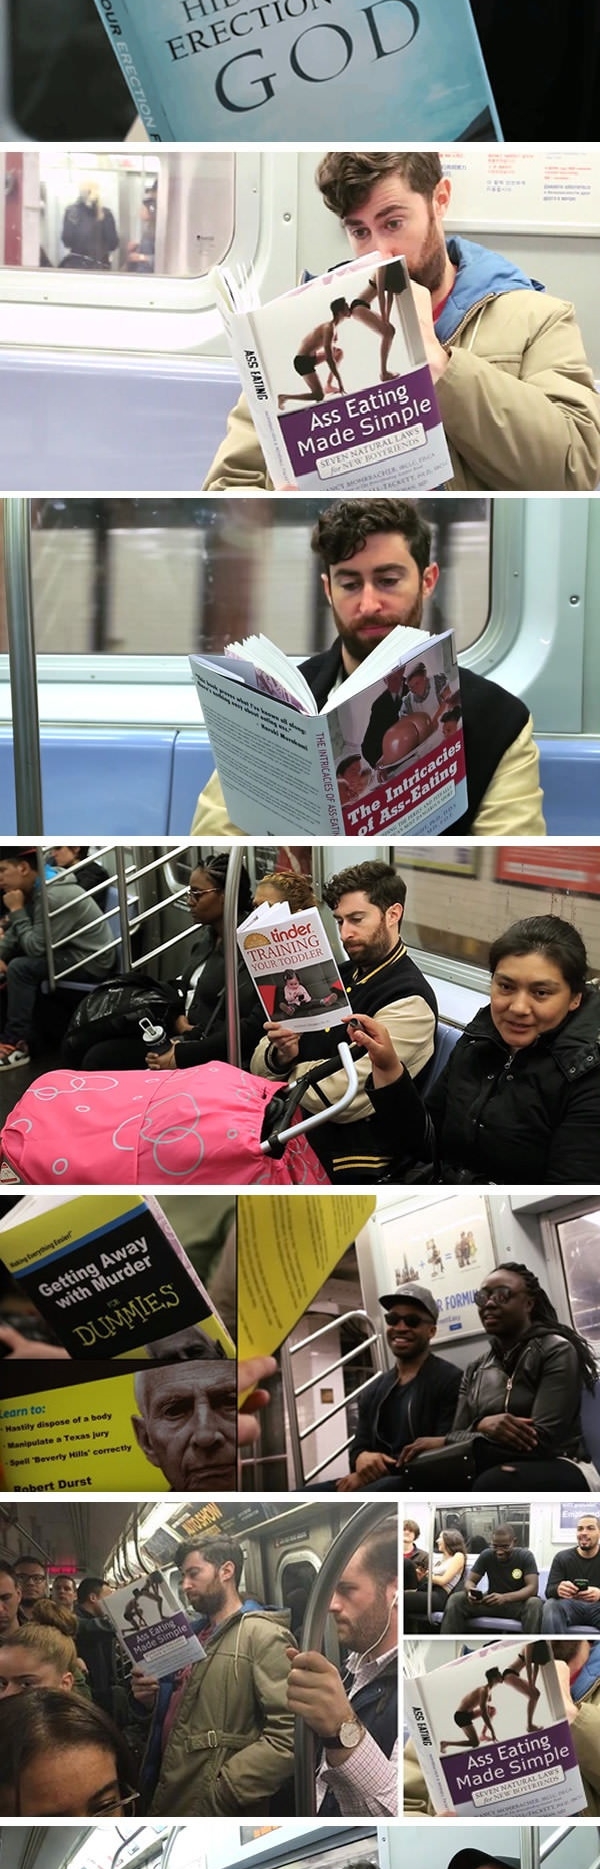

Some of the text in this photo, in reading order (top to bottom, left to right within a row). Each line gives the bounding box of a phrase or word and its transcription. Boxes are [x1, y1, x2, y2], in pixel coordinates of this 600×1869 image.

[297, 398, 432, 457] Made Simple
[310, 384, 410, 432] Ass Eating
[347, 739, 462, 826] The Intricacies
[357, 759, 458, 836] of Ass-Eating
[247, 934, 320, 962] TRAINING
[251, 948, 324, 973] YOUR TODDLER
[270, 923, 312, 943] tinder
[38, 1235, 150, 1298] Getting Away
[55, 1255, 152, 1310] with Murder
[72, 1283, 181, 1347] DUMMIES
